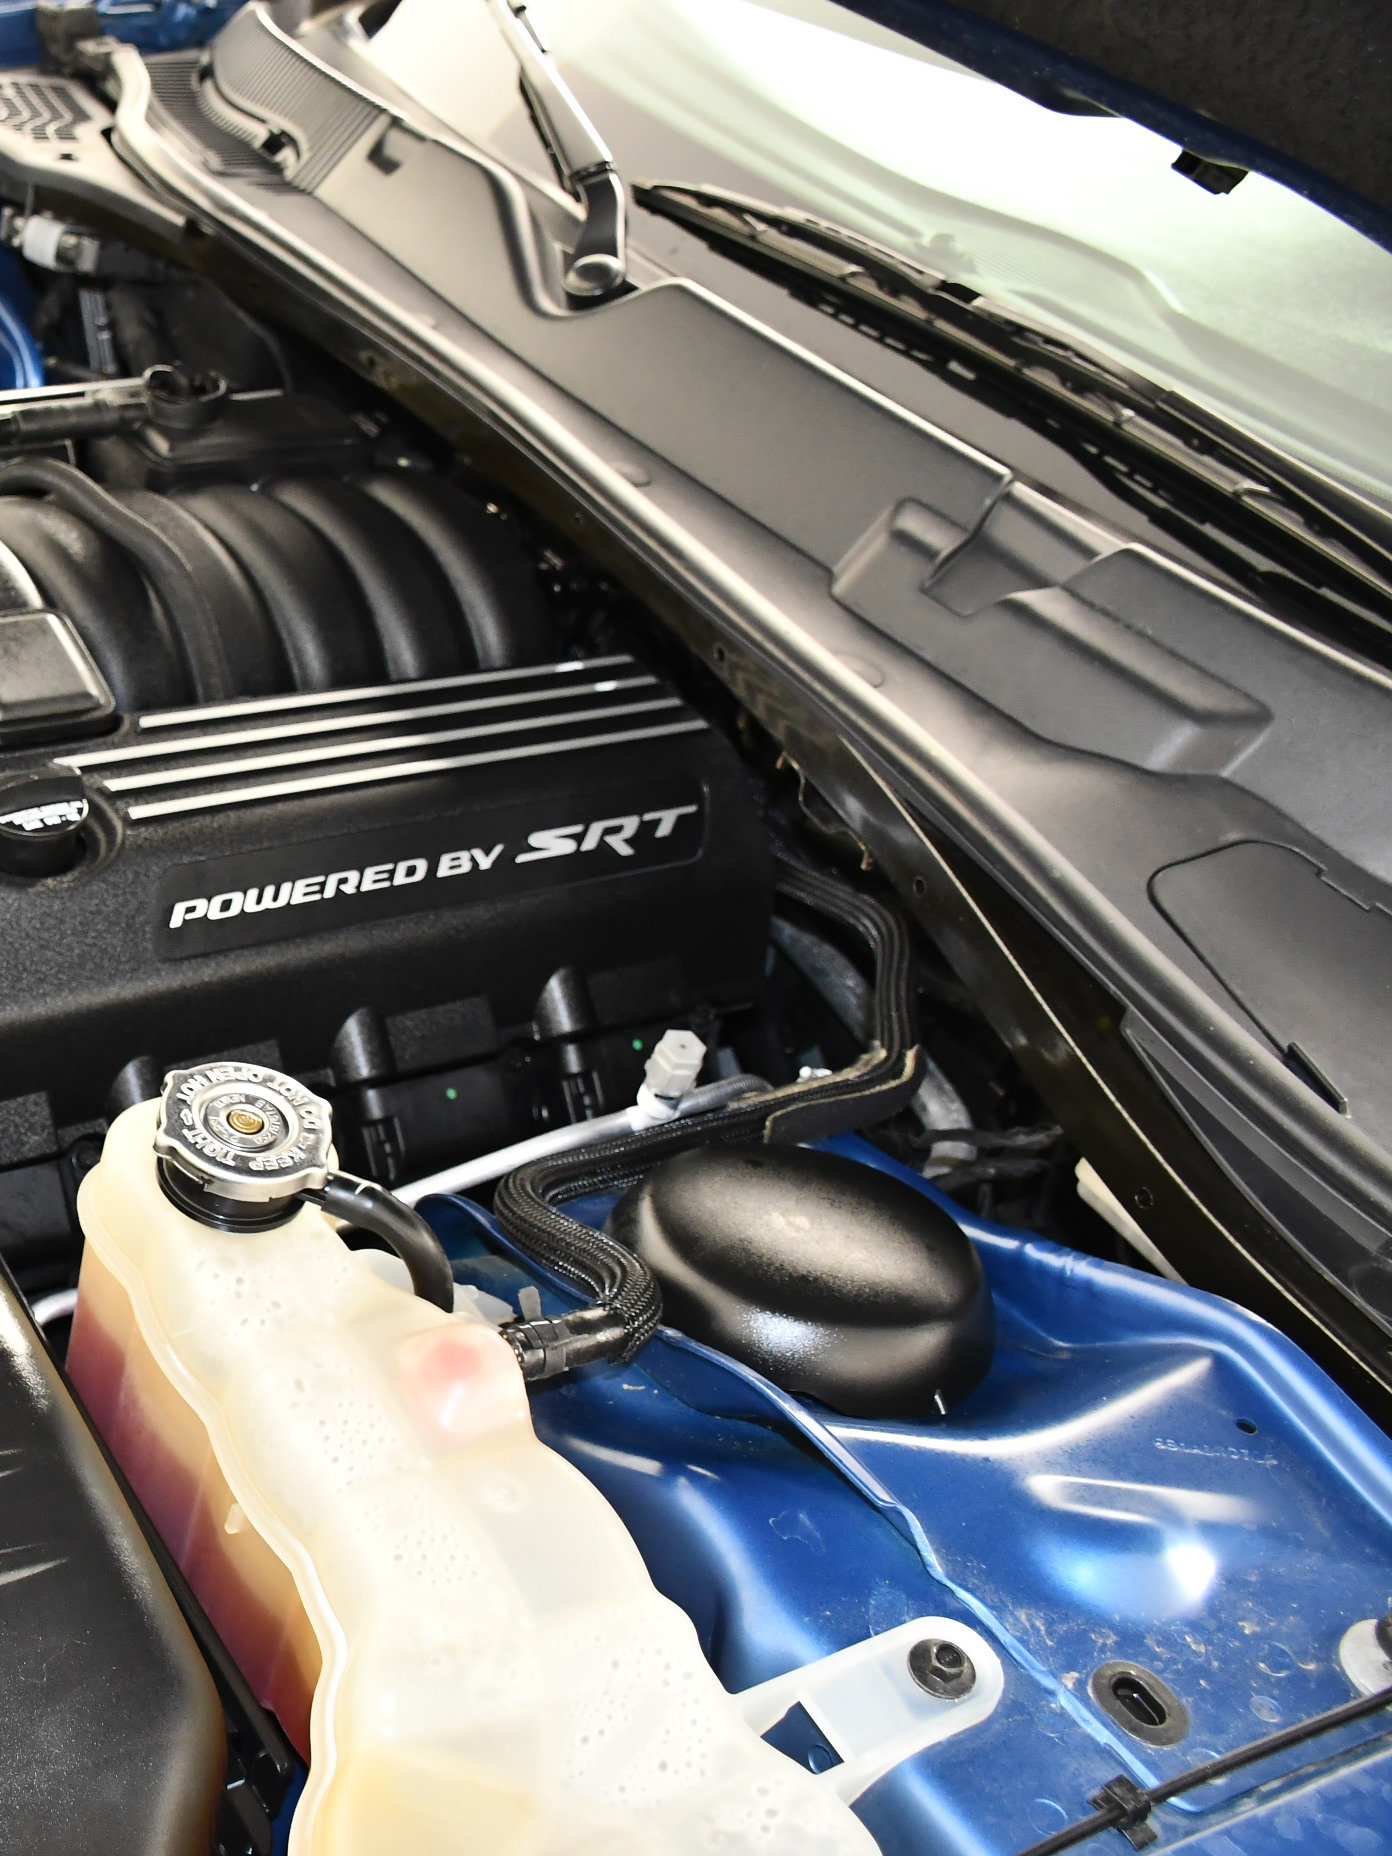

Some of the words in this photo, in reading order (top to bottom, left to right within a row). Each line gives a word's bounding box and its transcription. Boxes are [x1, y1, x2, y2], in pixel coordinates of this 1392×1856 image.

[168, 857, 429, 929] POWERED
[436, 843, 505, 878] BY
[515, 804, 698, 864] SRT
[176, 1074, 205, 1105] HOT
[206, 1066, 264, 1084] OPEN
[266, 1075, 307, 1106] NOT
[299, 1106, 321, 1130] DO
[181, 1128, 236, 1167] TIGHT
[249, 1150, 306, 1171] KEEP
